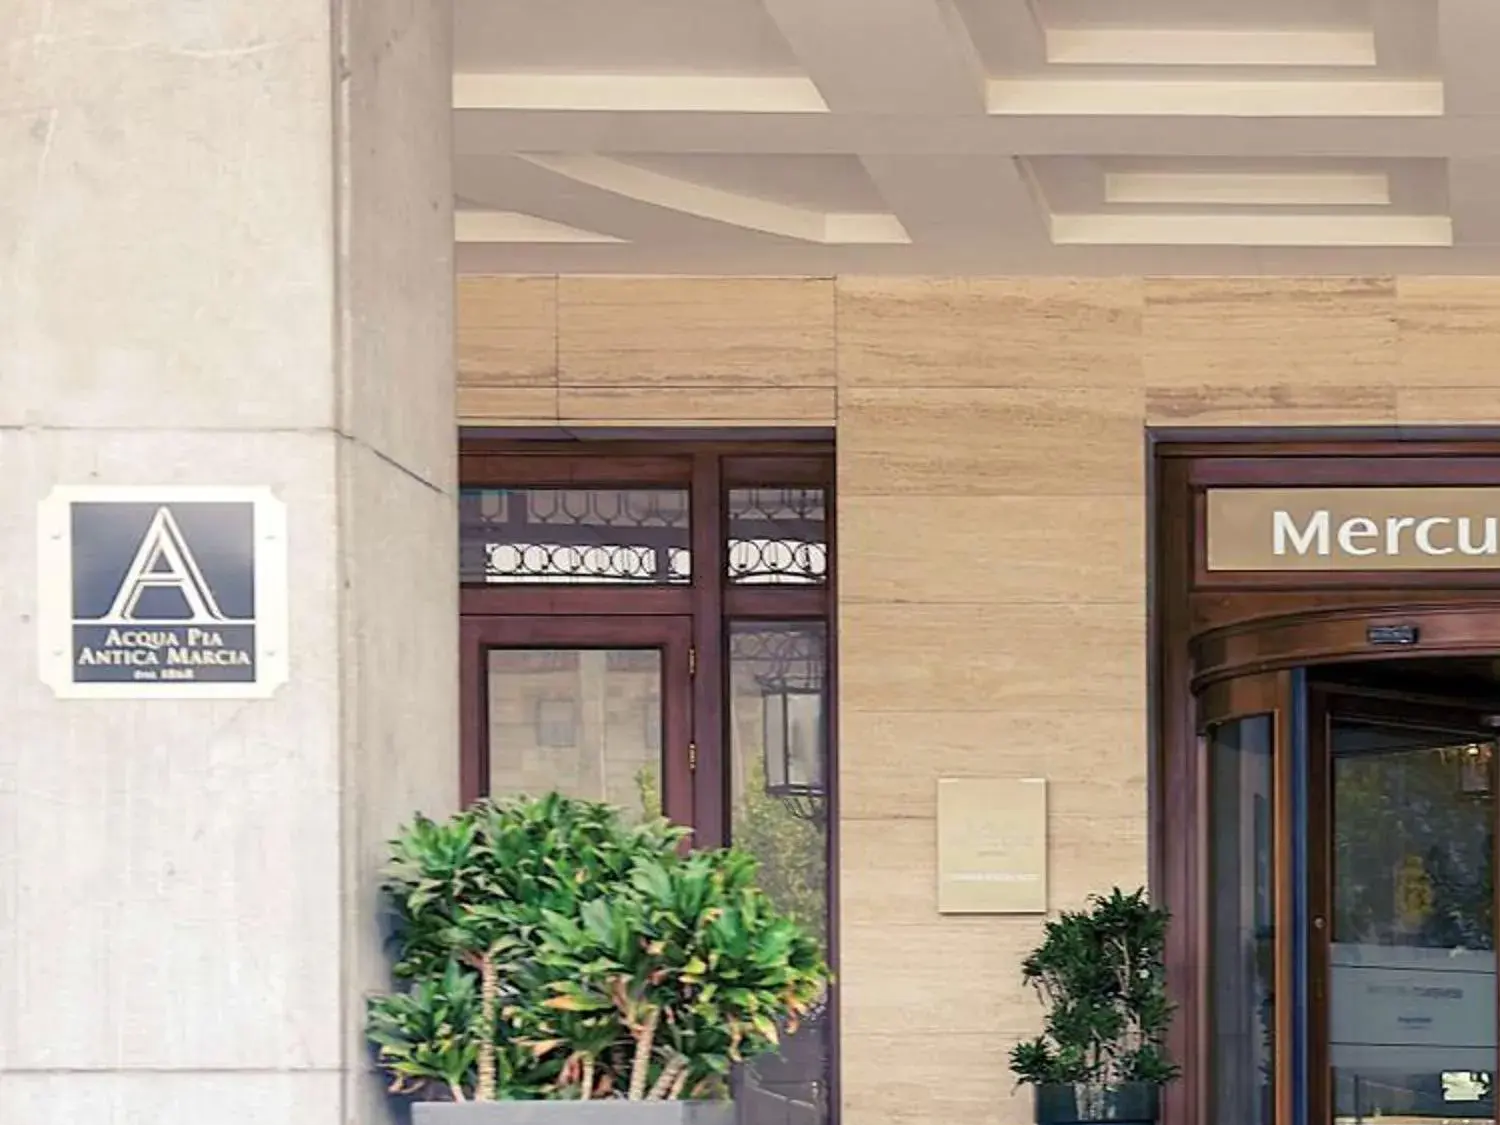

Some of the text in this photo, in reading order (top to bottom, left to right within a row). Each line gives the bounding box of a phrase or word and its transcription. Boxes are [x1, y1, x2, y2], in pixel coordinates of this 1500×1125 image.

[104, 628, 224, 649] ACQUA PIA
[78, 647, 252, 665] ANTICA MARCIA
